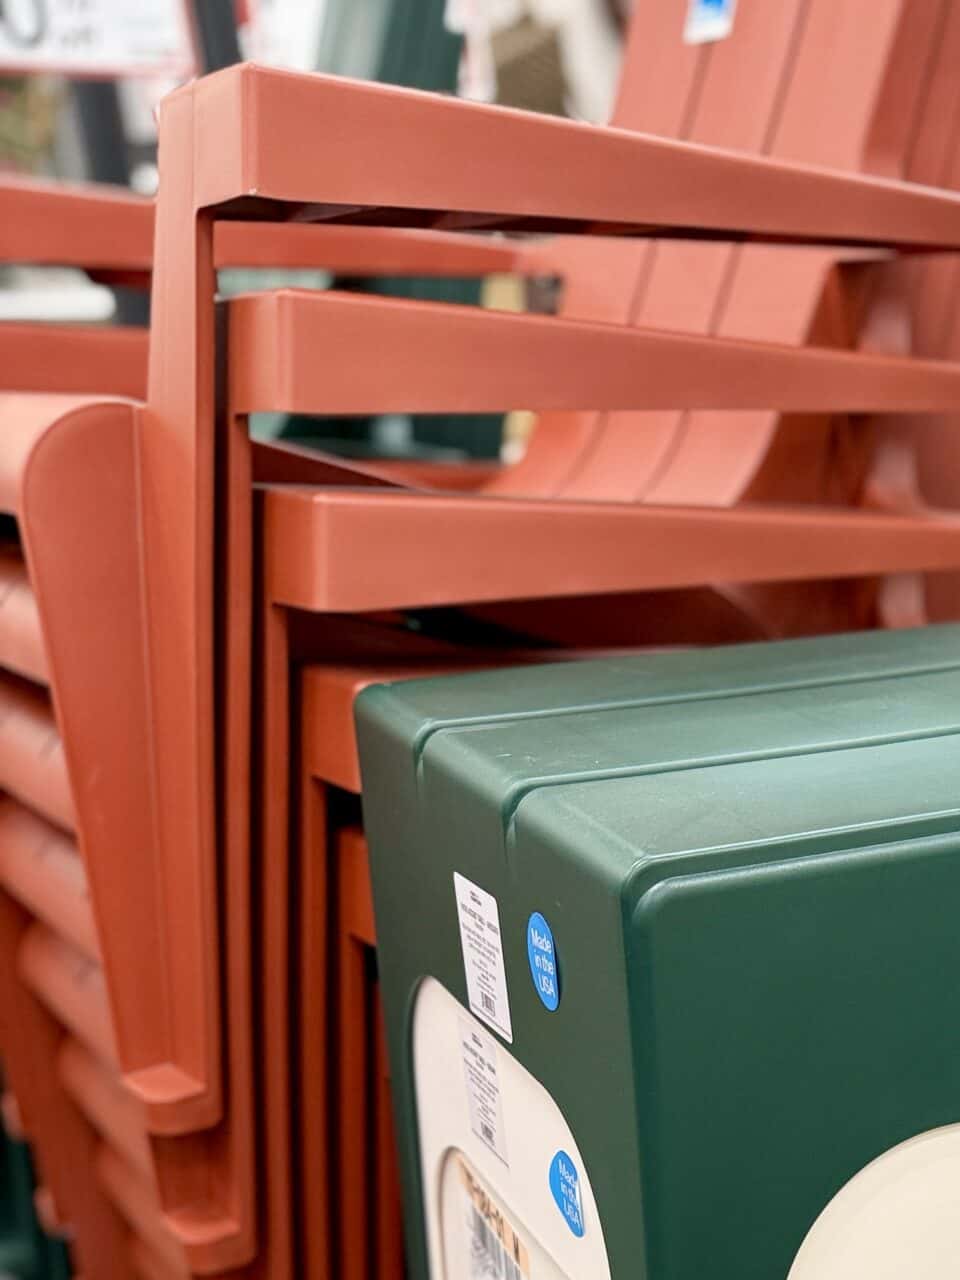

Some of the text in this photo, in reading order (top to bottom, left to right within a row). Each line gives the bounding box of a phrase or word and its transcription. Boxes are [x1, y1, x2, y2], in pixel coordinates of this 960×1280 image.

[531, 927, 552, 954] Made
[542, 953, 554, 976] the
[539, 974, 555, 996] USA
